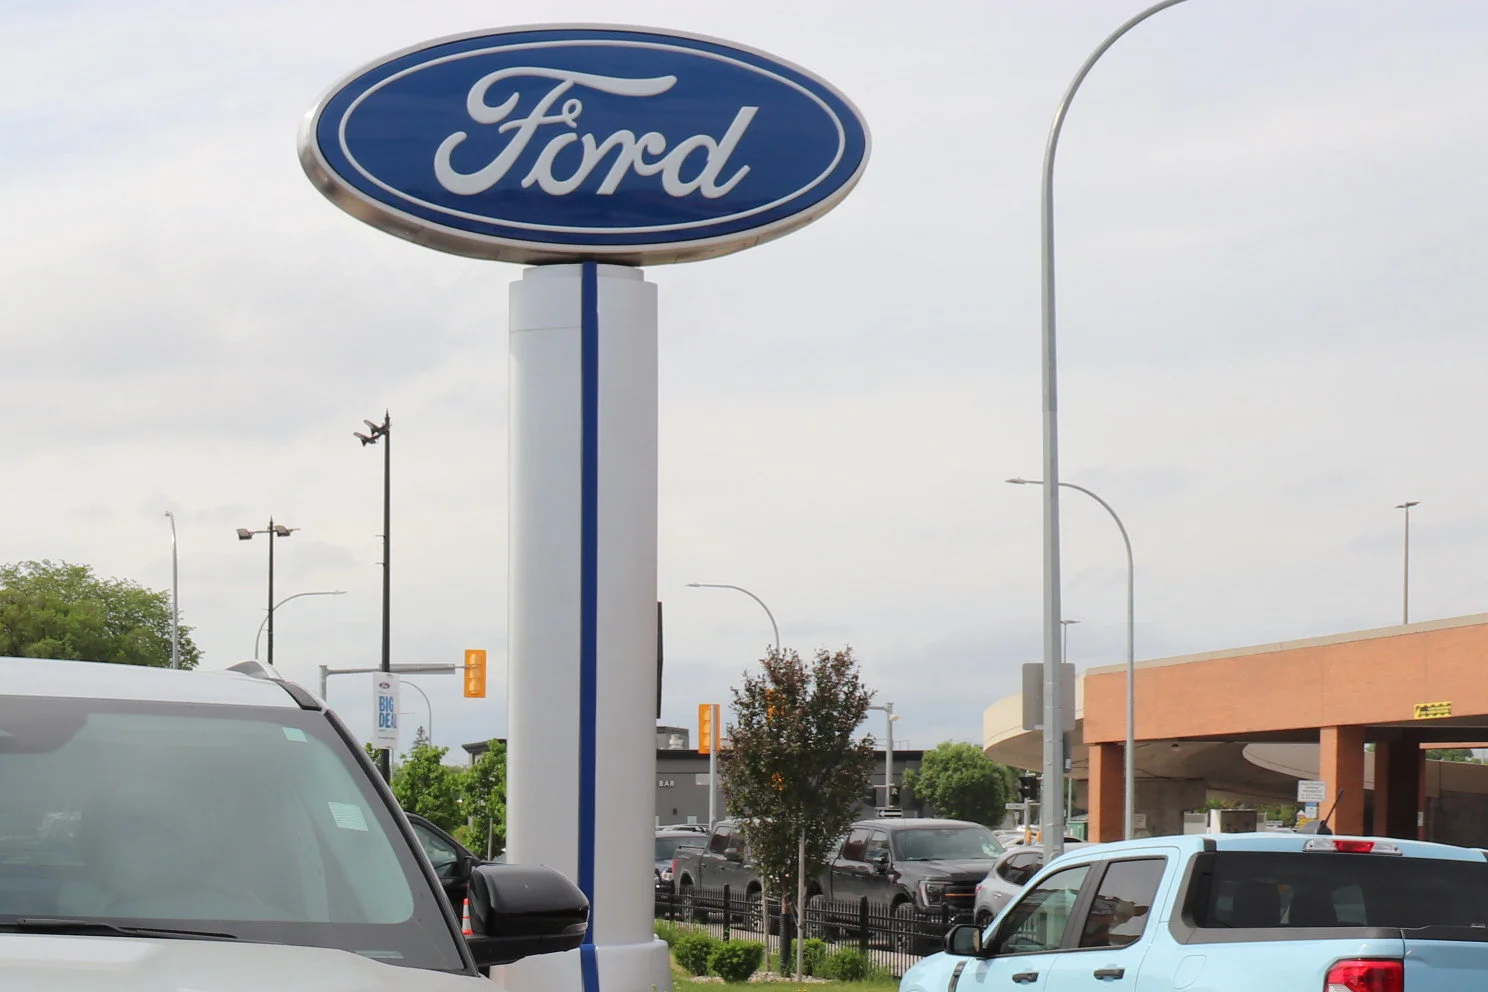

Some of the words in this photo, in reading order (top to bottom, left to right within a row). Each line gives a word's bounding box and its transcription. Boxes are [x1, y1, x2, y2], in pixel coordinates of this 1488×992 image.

[434, 66, 759, 199] Ford
[379, 695, 394, 712] BIG
[379, 712, 397, 728] DEAL
